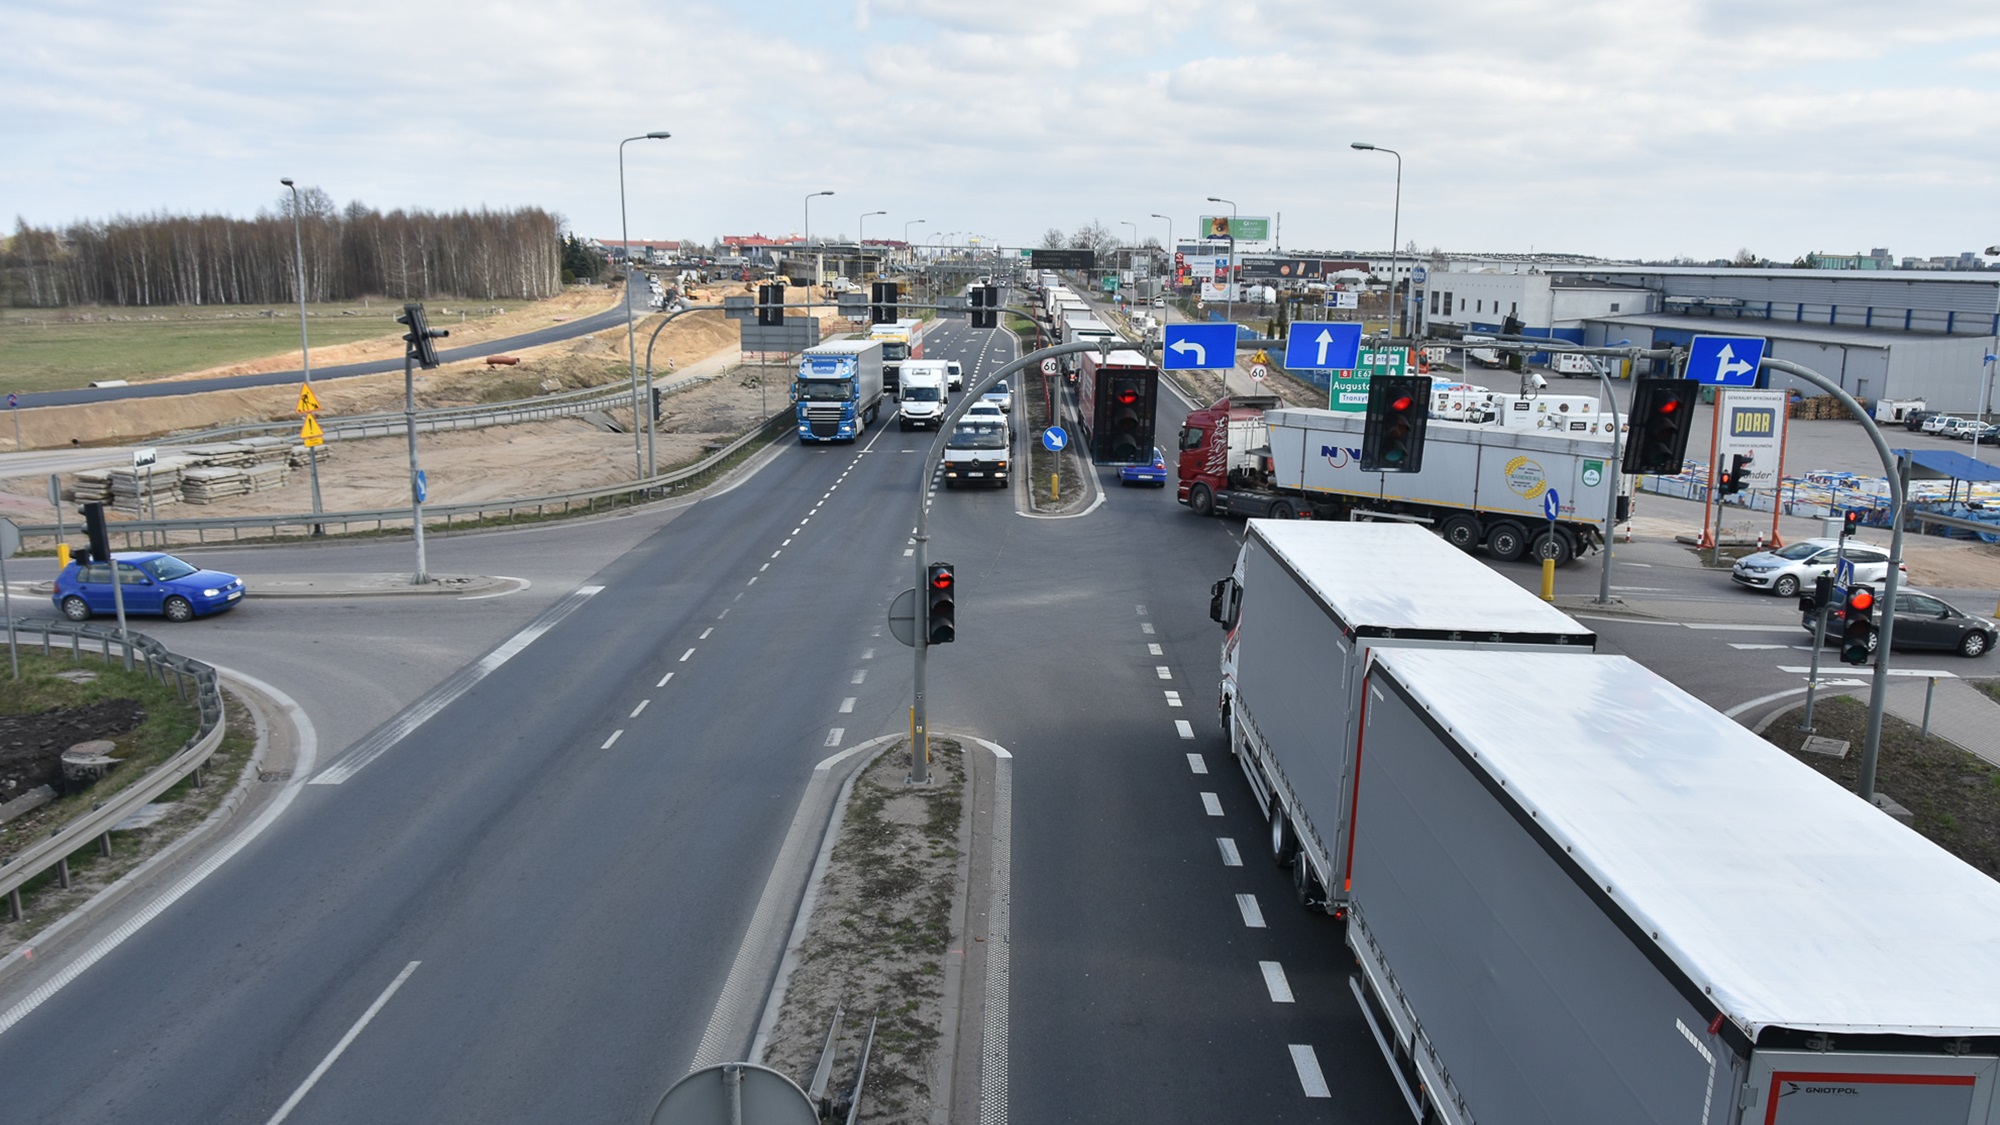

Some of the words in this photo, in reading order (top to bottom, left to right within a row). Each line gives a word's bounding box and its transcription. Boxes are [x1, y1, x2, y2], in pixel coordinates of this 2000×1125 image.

[1044, 361, 1056, 371] 60
[1252, 368, 1264, 378] 60
[1333, 381, 1370, 392] Augusto
[1321, 445, 1361, 468] NOV
